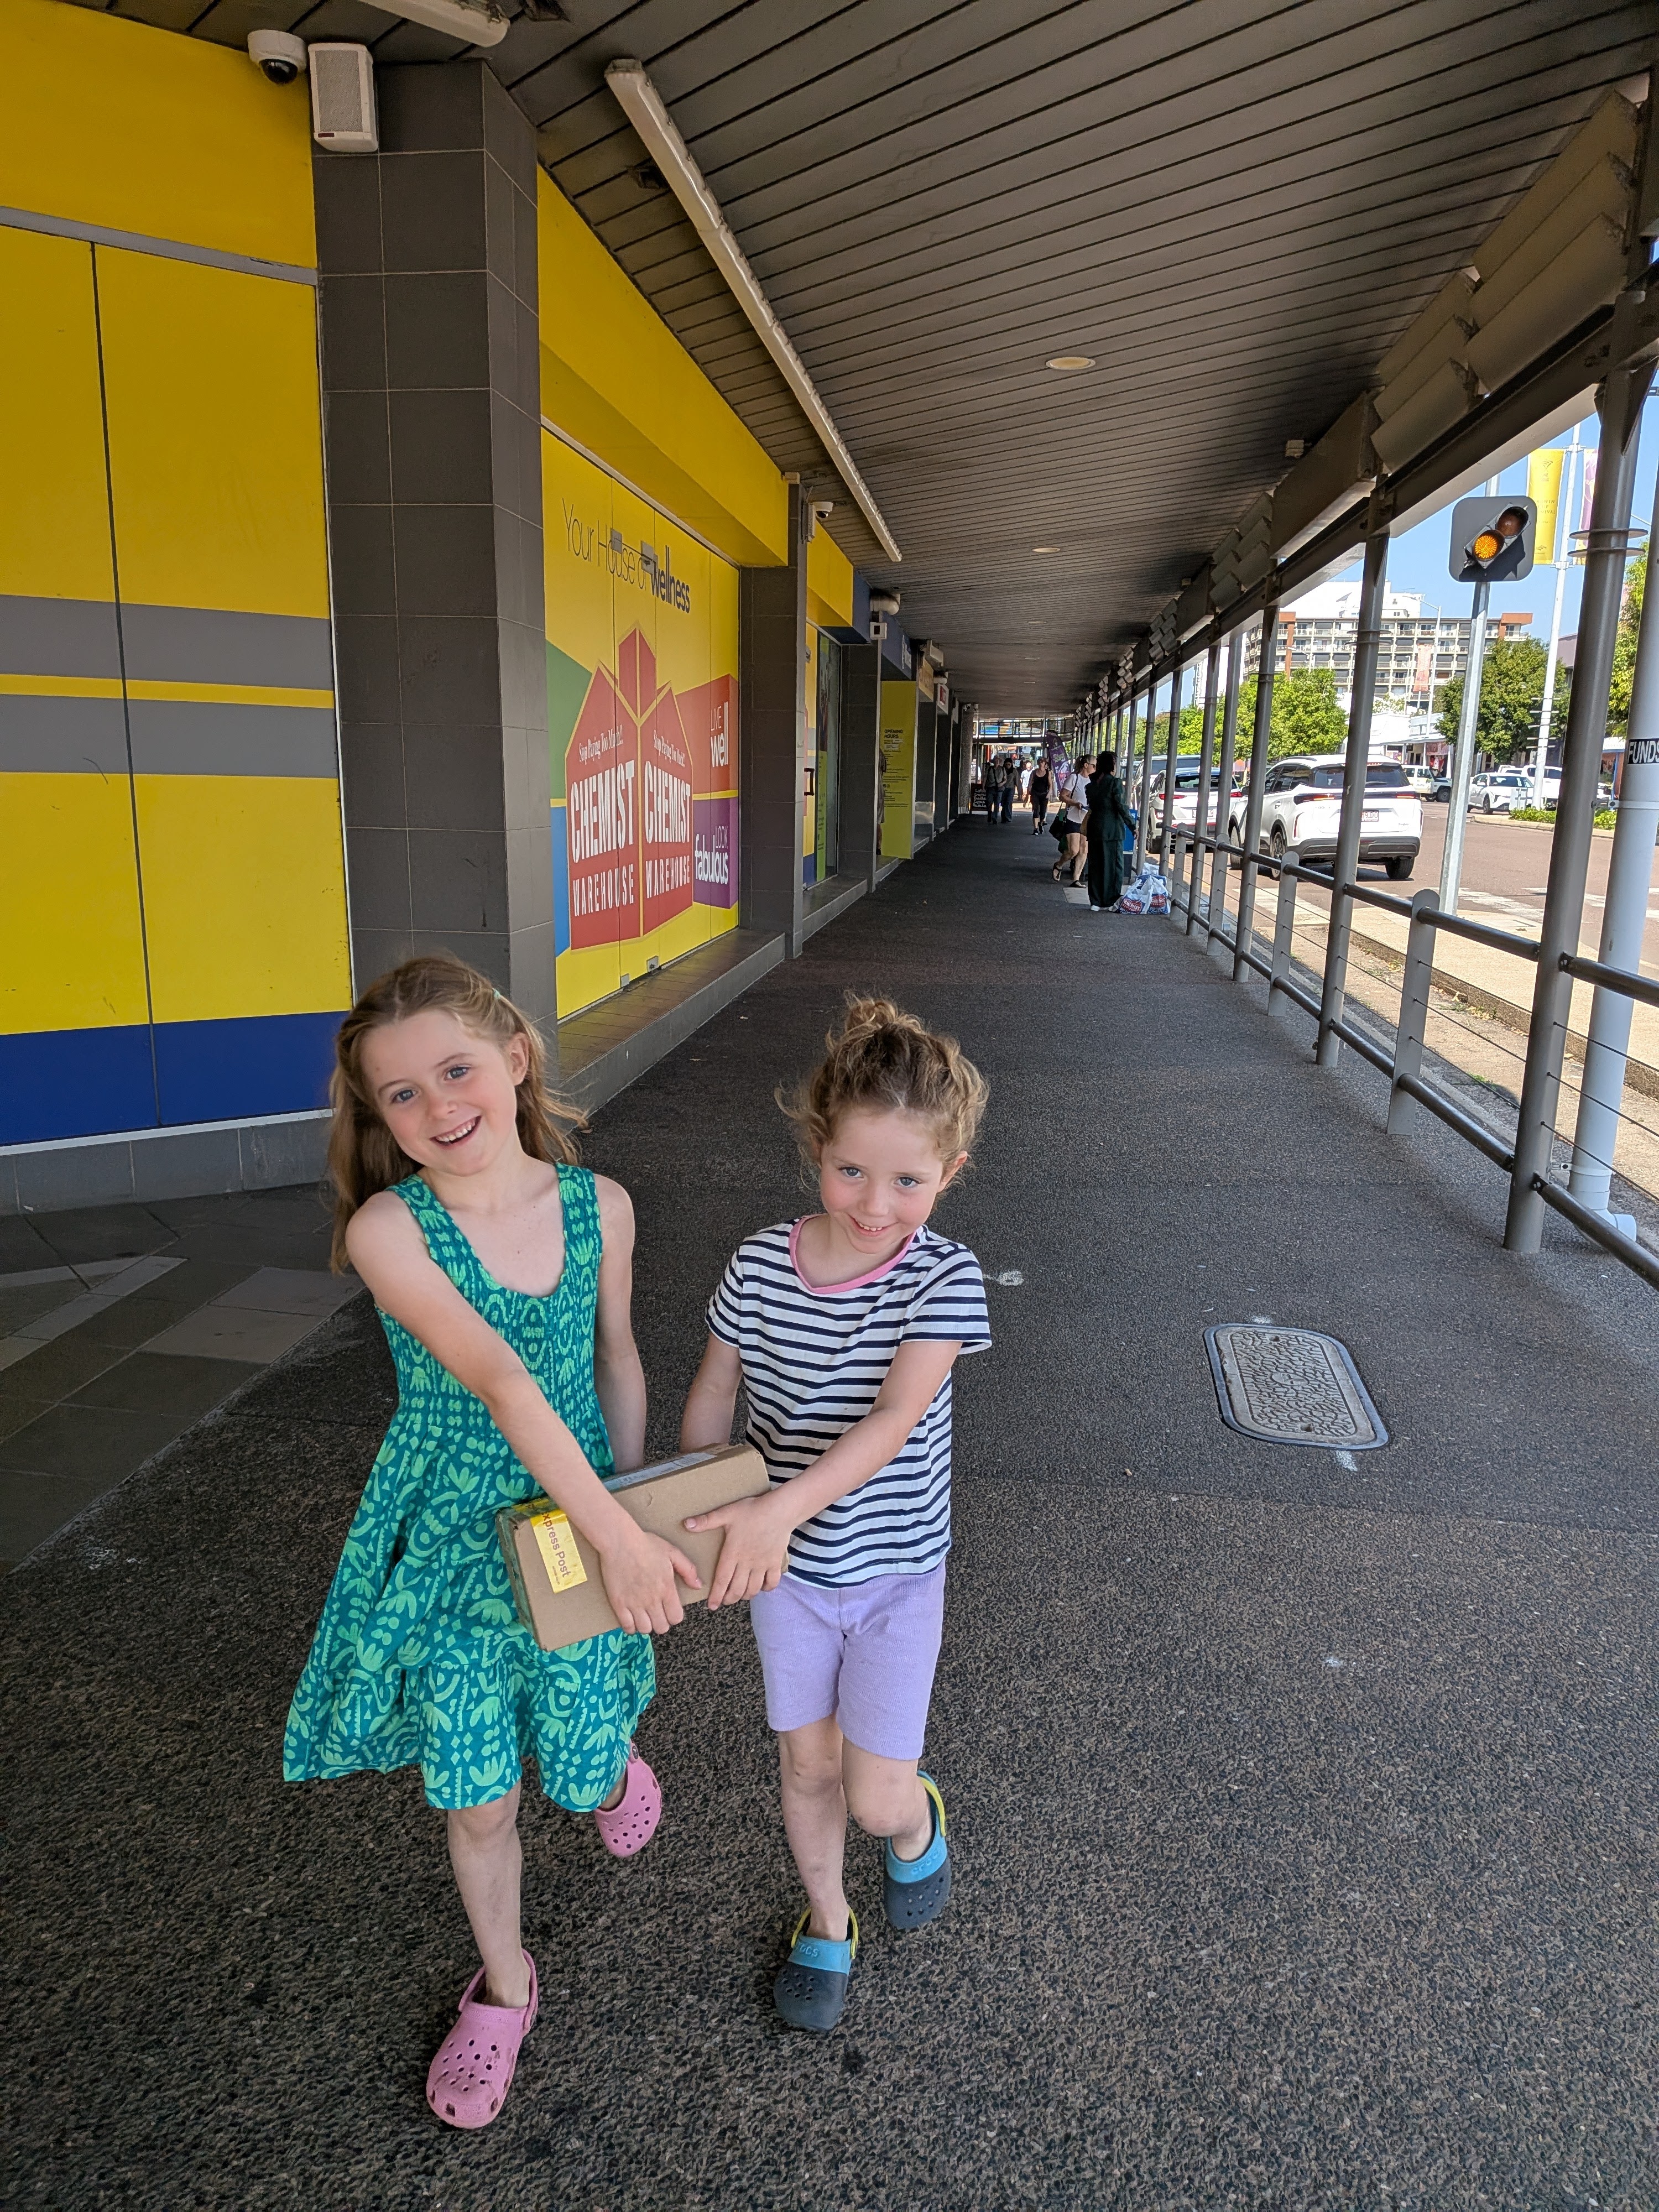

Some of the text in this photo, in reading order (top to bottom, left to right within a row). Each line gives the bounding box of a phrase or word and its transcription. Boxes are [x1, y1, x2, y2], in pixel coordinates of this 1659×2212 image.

[562, 498, 594, 563] Your
[597, 519, 635, 585] House
[650, 545, 690, 614] wellness
[710, 701, 728, 768] well
[711, 706, 722, 731] LIVE
[579, 743, 588, 765] Stop
[587, 736, 601, 761] Paying
[600, 733, 608, 752] Too
[653, 729, 661, 757] Stop
[661, 735, 671, 763] Paying
[571, 760, 634, 864] CHEMIST
[644, 760, 690, 844] CHEMIST
[695, 833, 728, 885] fabulous
[715, 826, 728, 849] LOOK
[573, 863, 634, 917] WAREHOUSE
[645, 855, 690, 899] WAREHOUSE
[555, 1550, 572, 1578] Post
